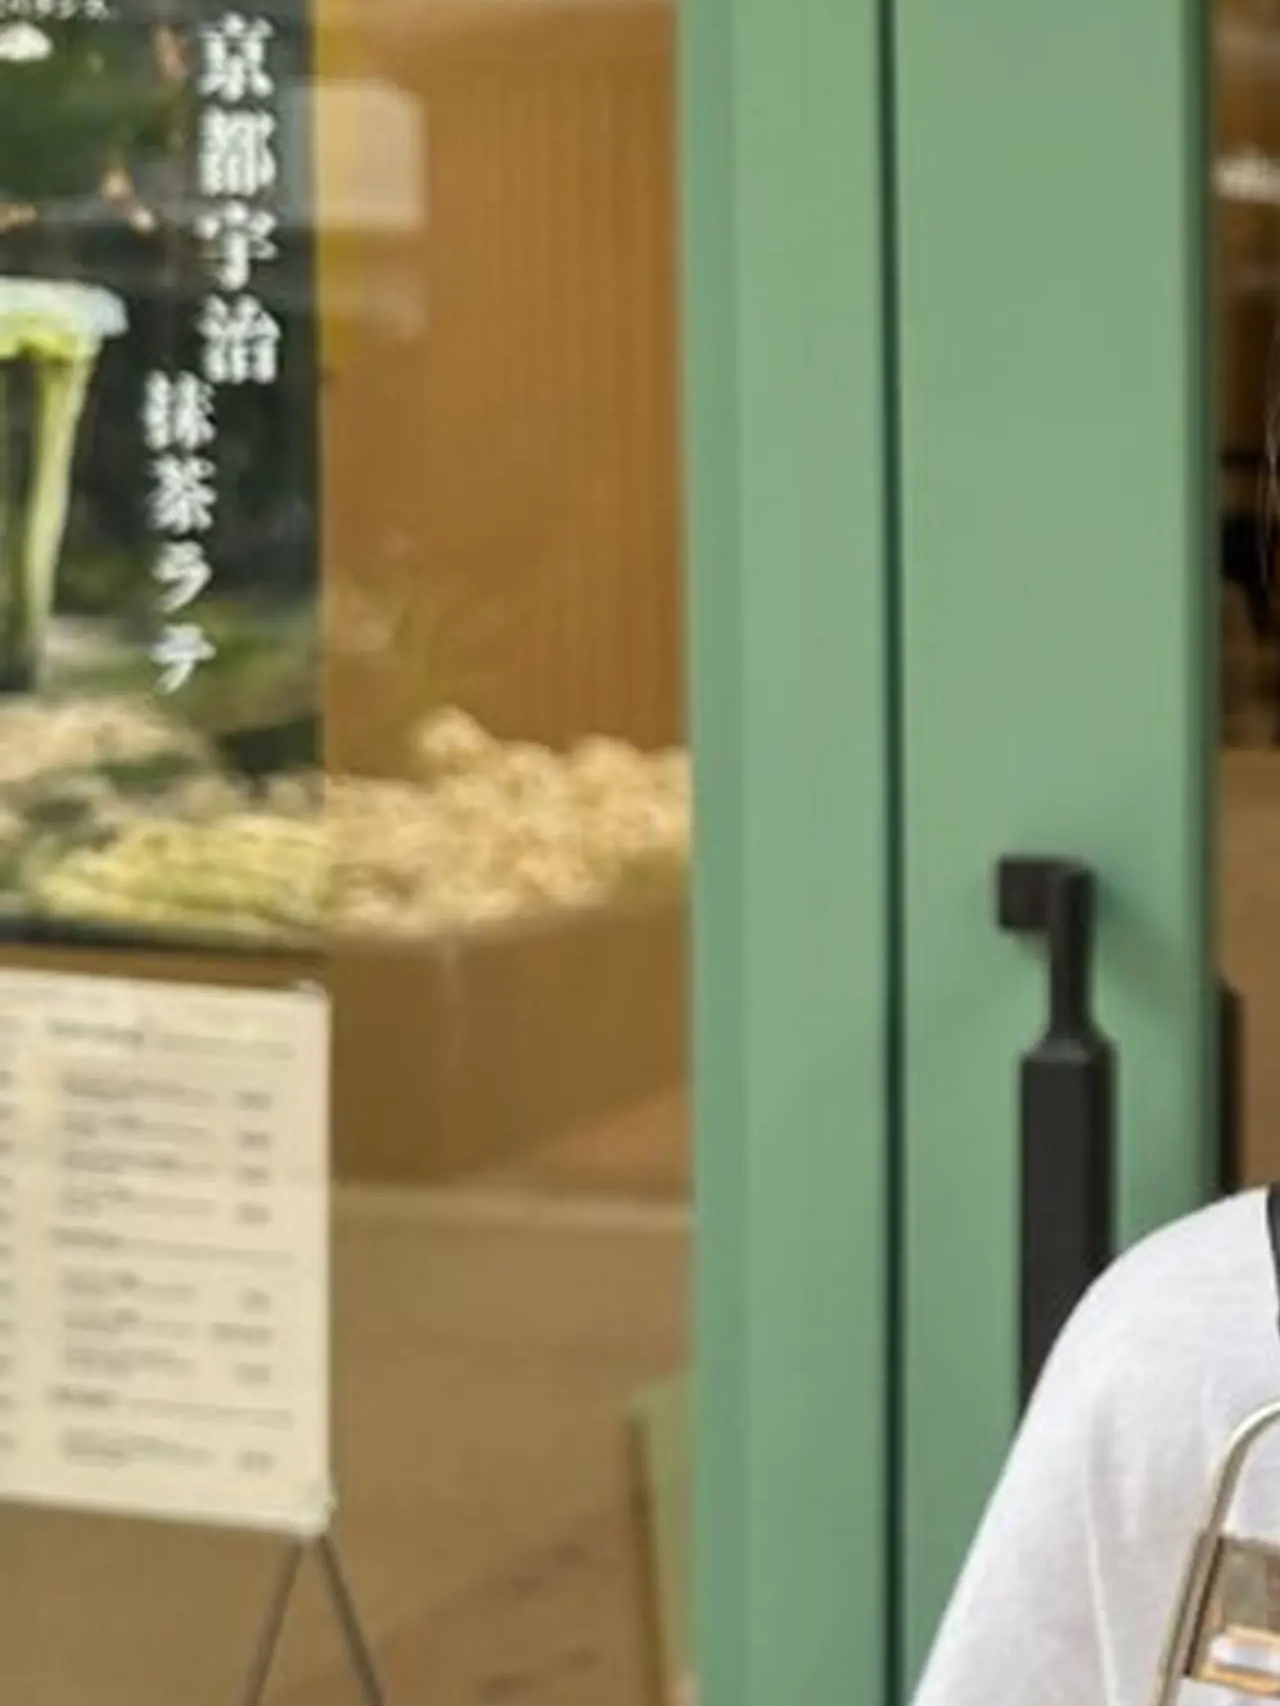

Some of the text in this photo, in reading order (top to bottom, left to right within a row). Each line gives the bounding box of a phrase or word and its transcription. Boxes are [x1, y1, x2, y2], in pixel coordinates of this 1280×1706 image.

[198, 11, 281, 385] 京都宇治
[144, 367, 218, 695] 抹茶ラテ
